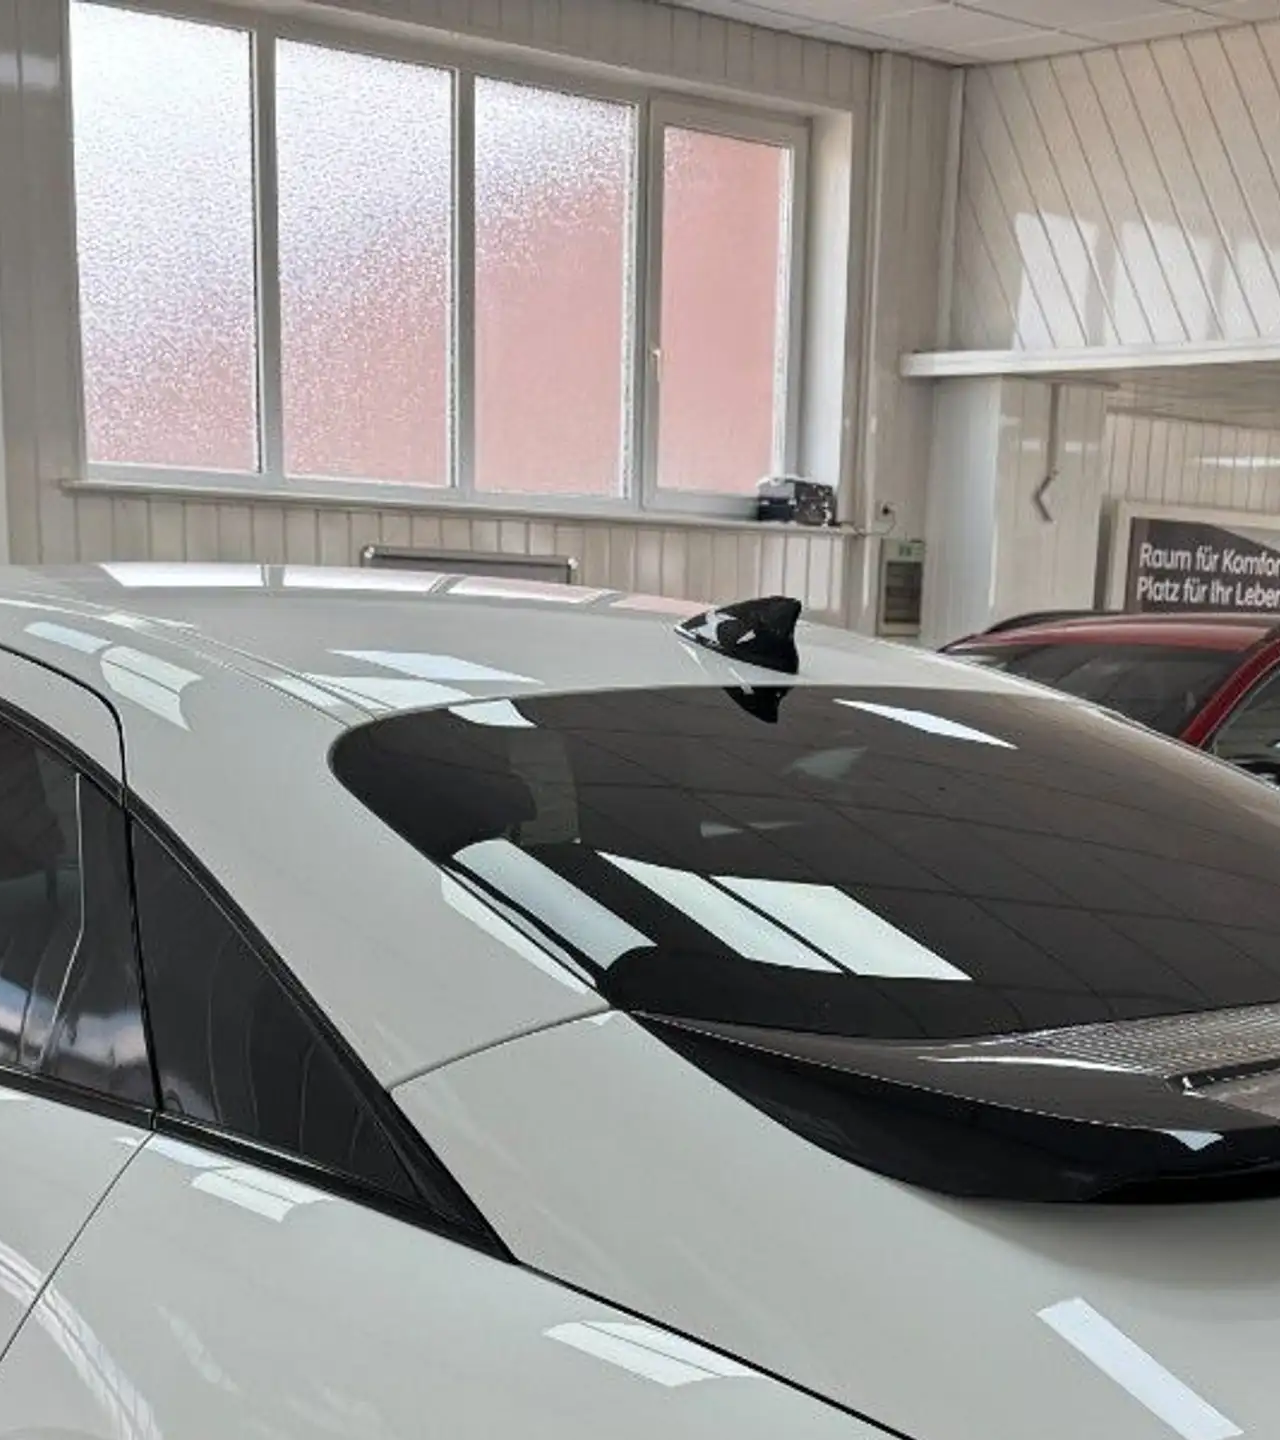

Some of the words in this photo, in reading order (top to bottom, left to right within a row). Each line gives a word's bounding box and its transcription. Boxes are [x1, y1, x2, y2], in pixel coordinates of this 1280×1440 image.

[1139, 543, 1191, 571] Raum
[1195, 545, 1219, 573] für
[1136, 576, 1180, 601] Platz
[1183, 577, 1207, 604] für
[1211, 579, 1233, 604] Ihr
